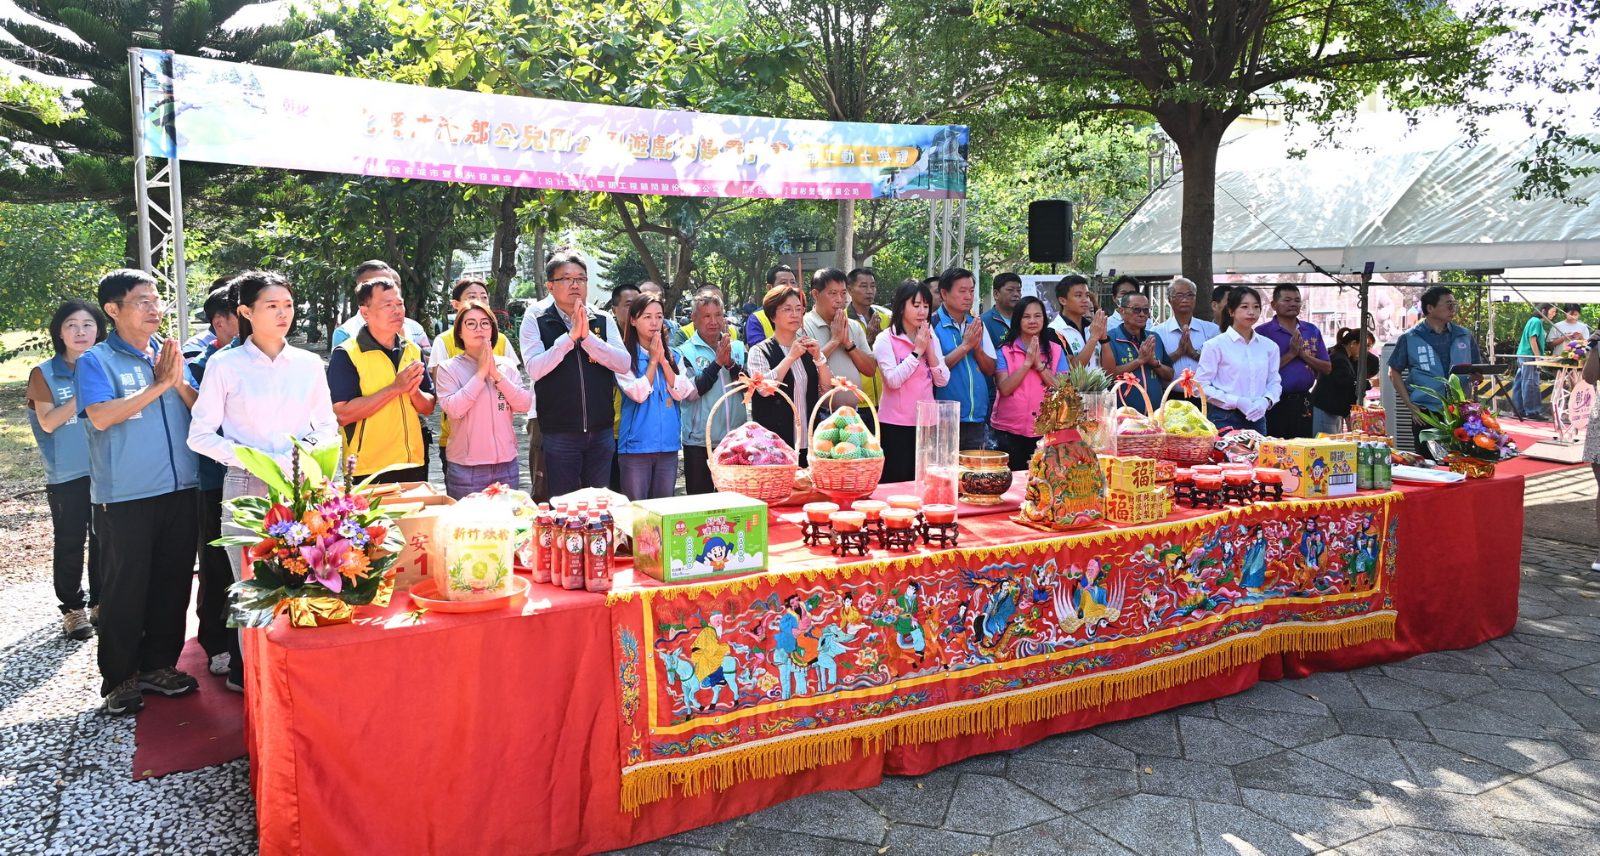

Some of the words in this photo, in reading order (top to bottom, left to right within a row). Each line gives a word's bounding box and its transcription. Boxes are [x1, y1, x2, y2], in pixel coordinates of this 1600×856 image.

[1132, 462, 1149, 488] 福
[1108, 493, 1129, 520] 福
[409, 532, 429, 552] 安
